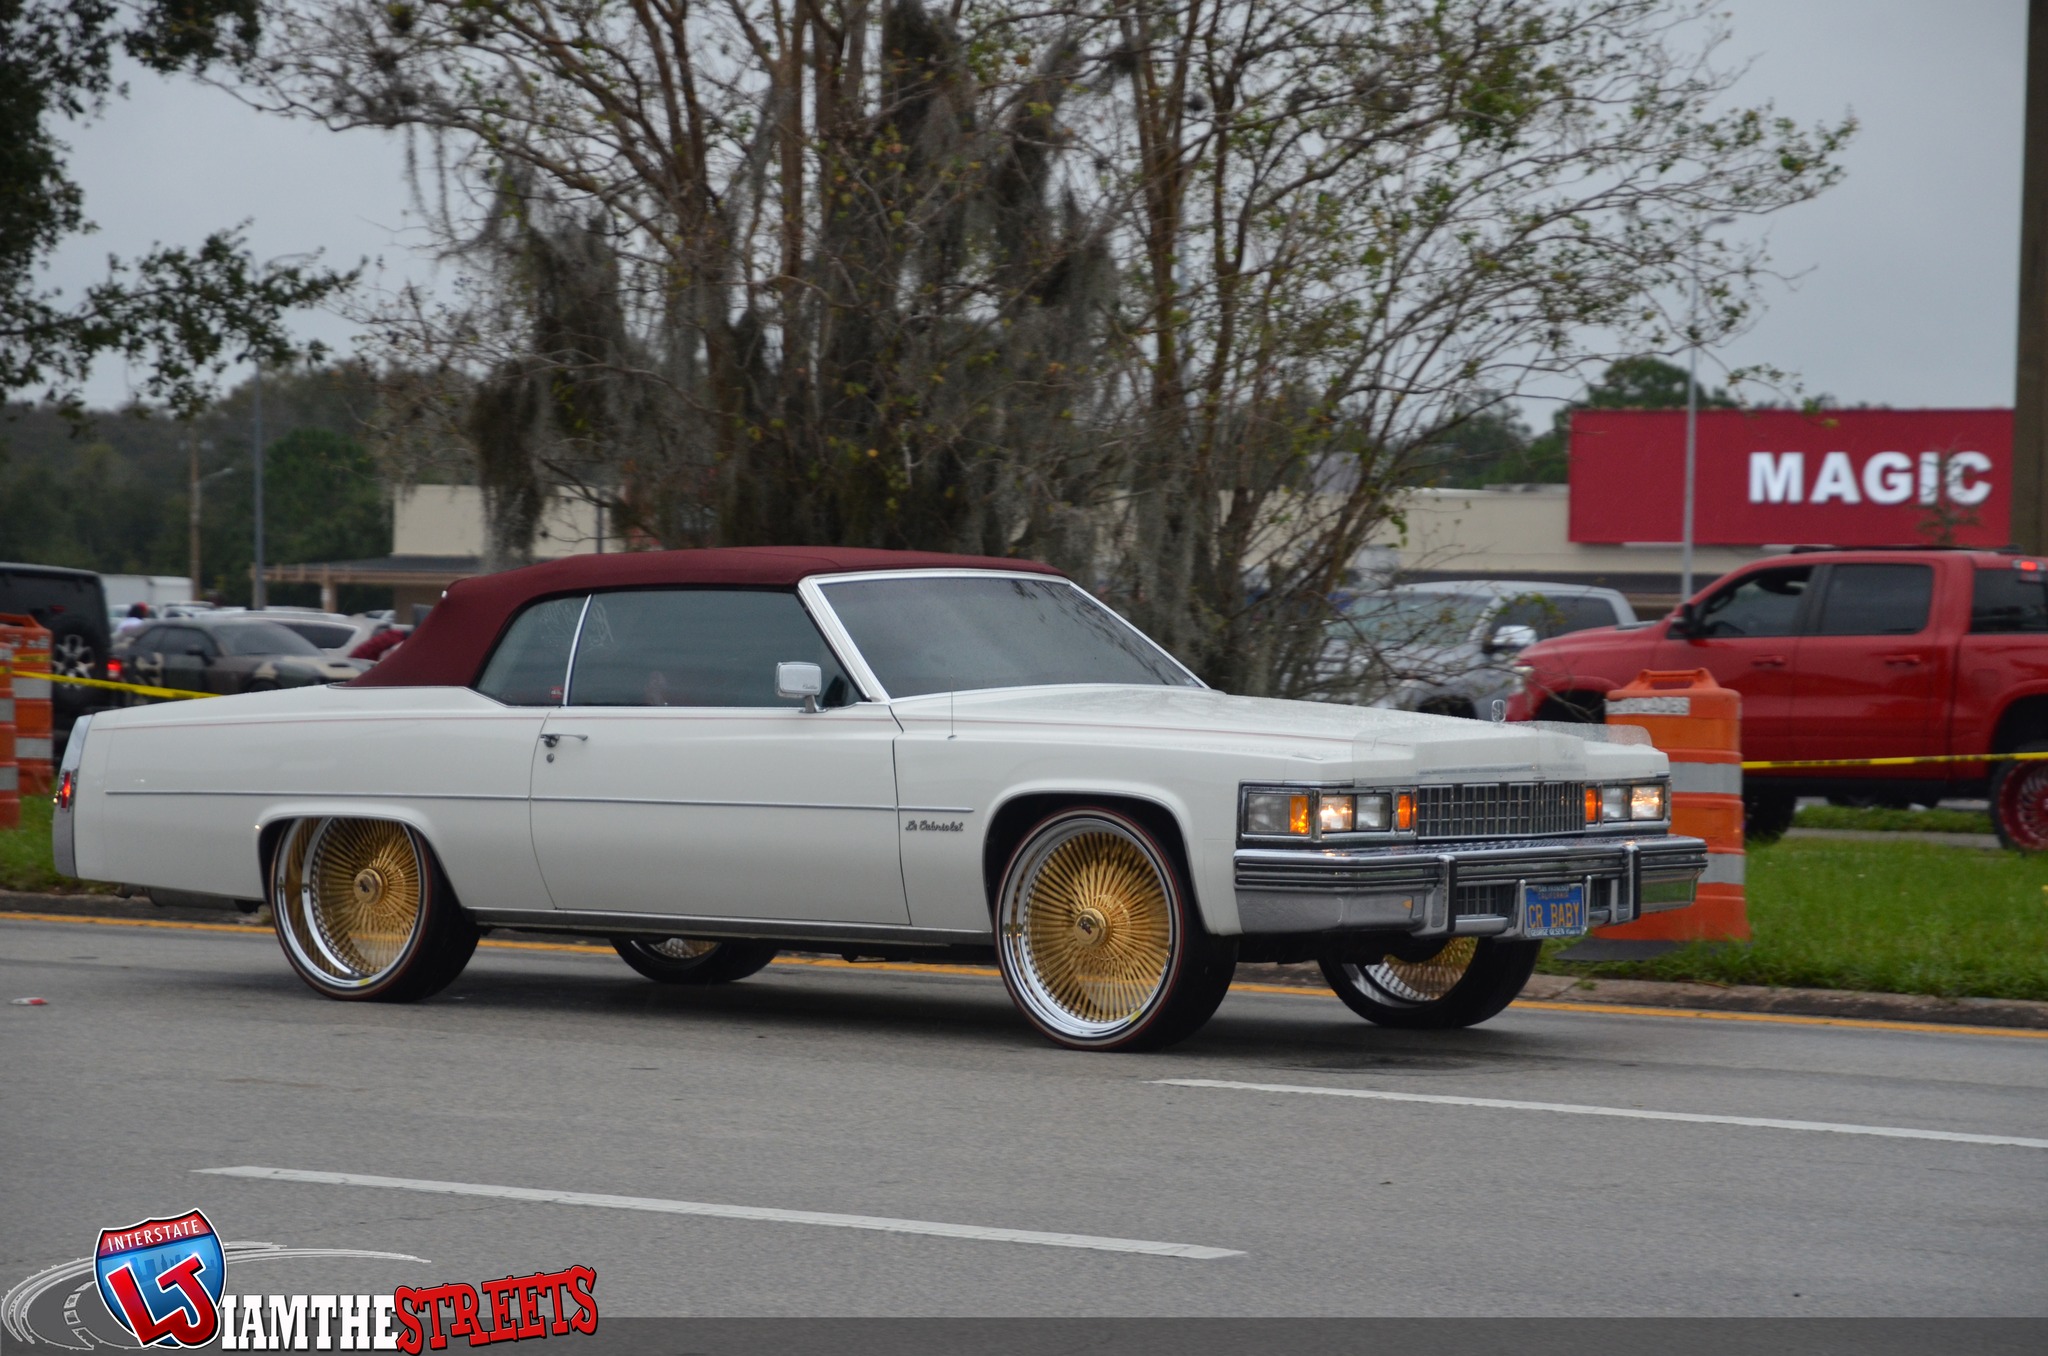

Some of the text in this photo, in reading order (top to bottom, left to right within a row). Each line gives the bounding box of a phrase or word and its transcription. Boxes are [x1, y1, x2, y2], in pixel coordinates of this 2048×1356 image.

[1750, 451, 1992, 504] MAGIC
[1528, 902, 1580, 928] CR BABY
